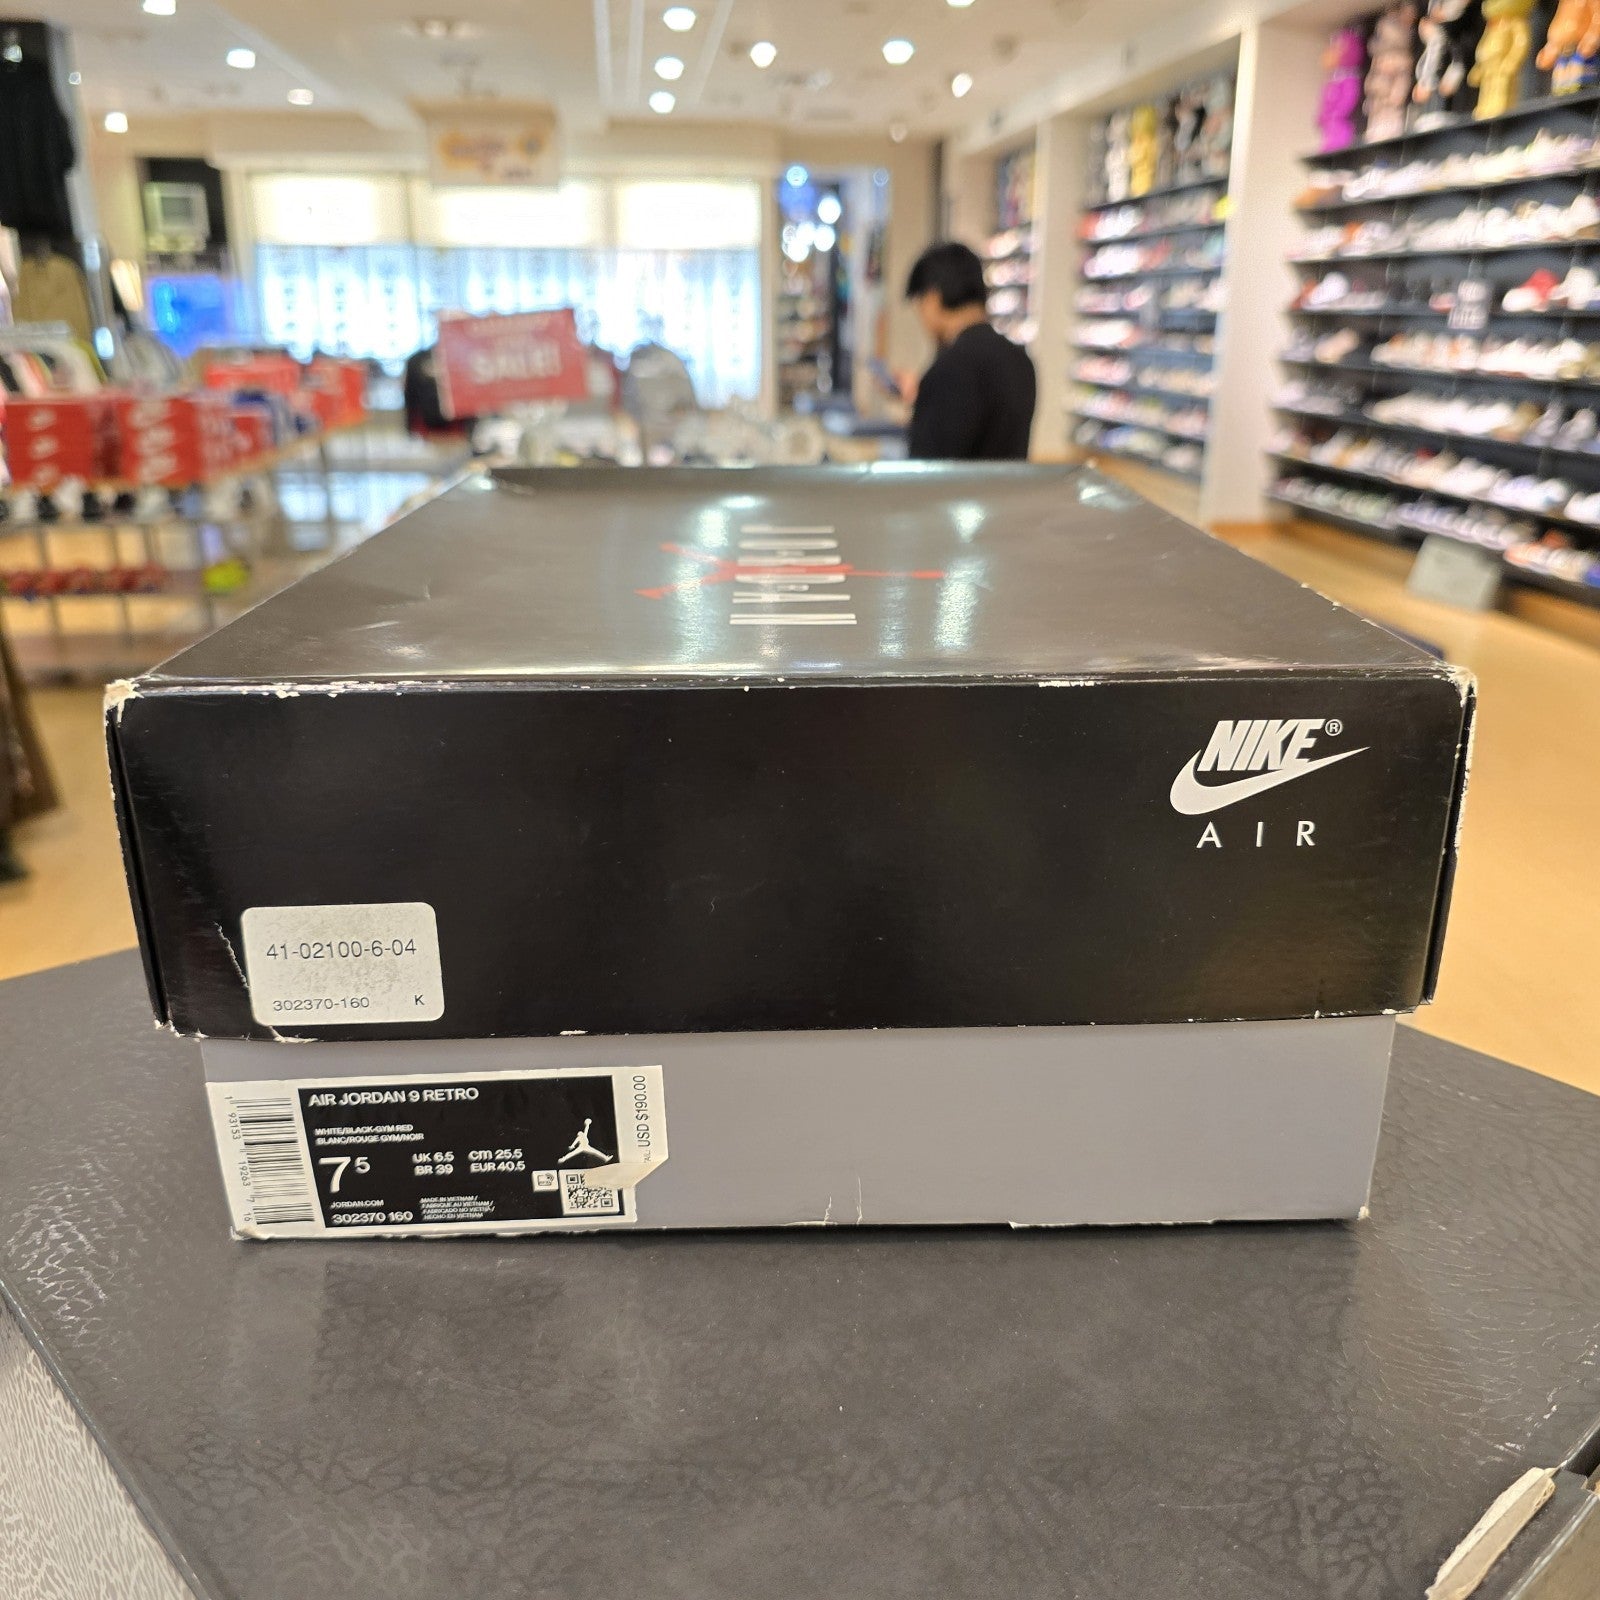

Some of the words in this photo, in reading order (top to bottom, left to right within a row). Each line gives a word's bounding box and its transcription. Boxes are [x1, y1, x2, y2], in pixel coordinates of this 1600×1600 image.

[1196, 821, 1316, 848] AIR
[266, 938, 417, 960] 41-02100-6-04
[273, 996, 370, 1011] 302370-160
[414, 994, 425, 1006] K
[308, 1093, 337, 1107] AIR
[338, 1090, 406, 1106] JORDAN
[407, 1090, 420, 1102] 9
[422, 1087, 479, 1101] RETRO
[633, 1075, 649, 1121] $190.00
[636, 1123, 651, 1147] USD
[228, 1112, 241, 1140] 93153
[238, 1161, 251, 1187] 19263
[412, 1153, 432, 1163] UK
[433, 1151, 455, 1162] 6.5
[494, 1149, 523, 1160] 25.5
[414, 1165, 433, 1176] BR
[435, 1164, 454, 1175] 39
[470, 1162, 497, 1173] EUR
[497, 1161, 526, 1171] 40.5
[330, 1200, 384, 1209] JORDAN.COM
[332, 1212, 386, 1224] 302370
[388, 1211, 413, 1223] 160
